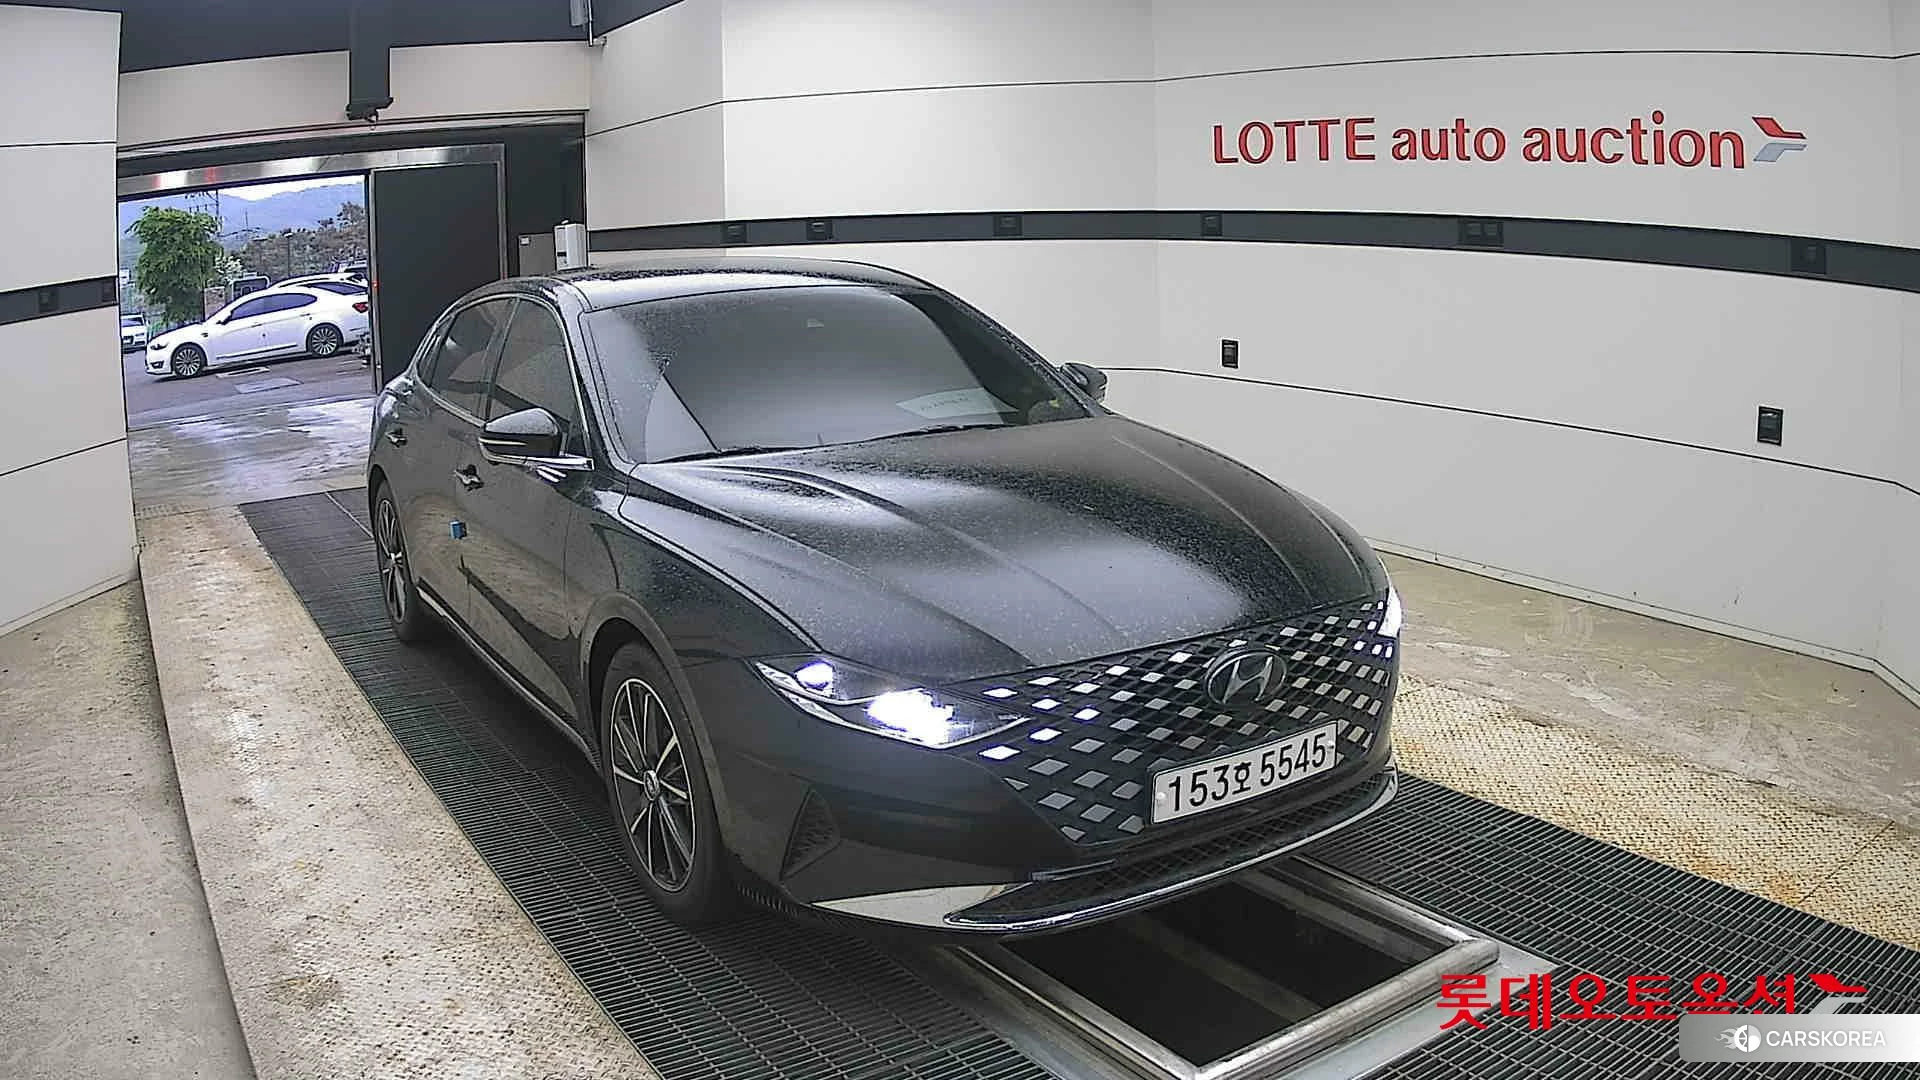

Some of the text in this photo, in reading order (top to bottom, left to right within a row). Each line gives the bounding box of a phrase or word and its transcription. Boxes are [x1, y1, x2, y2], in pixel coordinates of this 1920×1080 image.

[1212, 110, 1746, 169] LOTTE auto auction
[1168, 733, 1327, 811] 153호 5545
